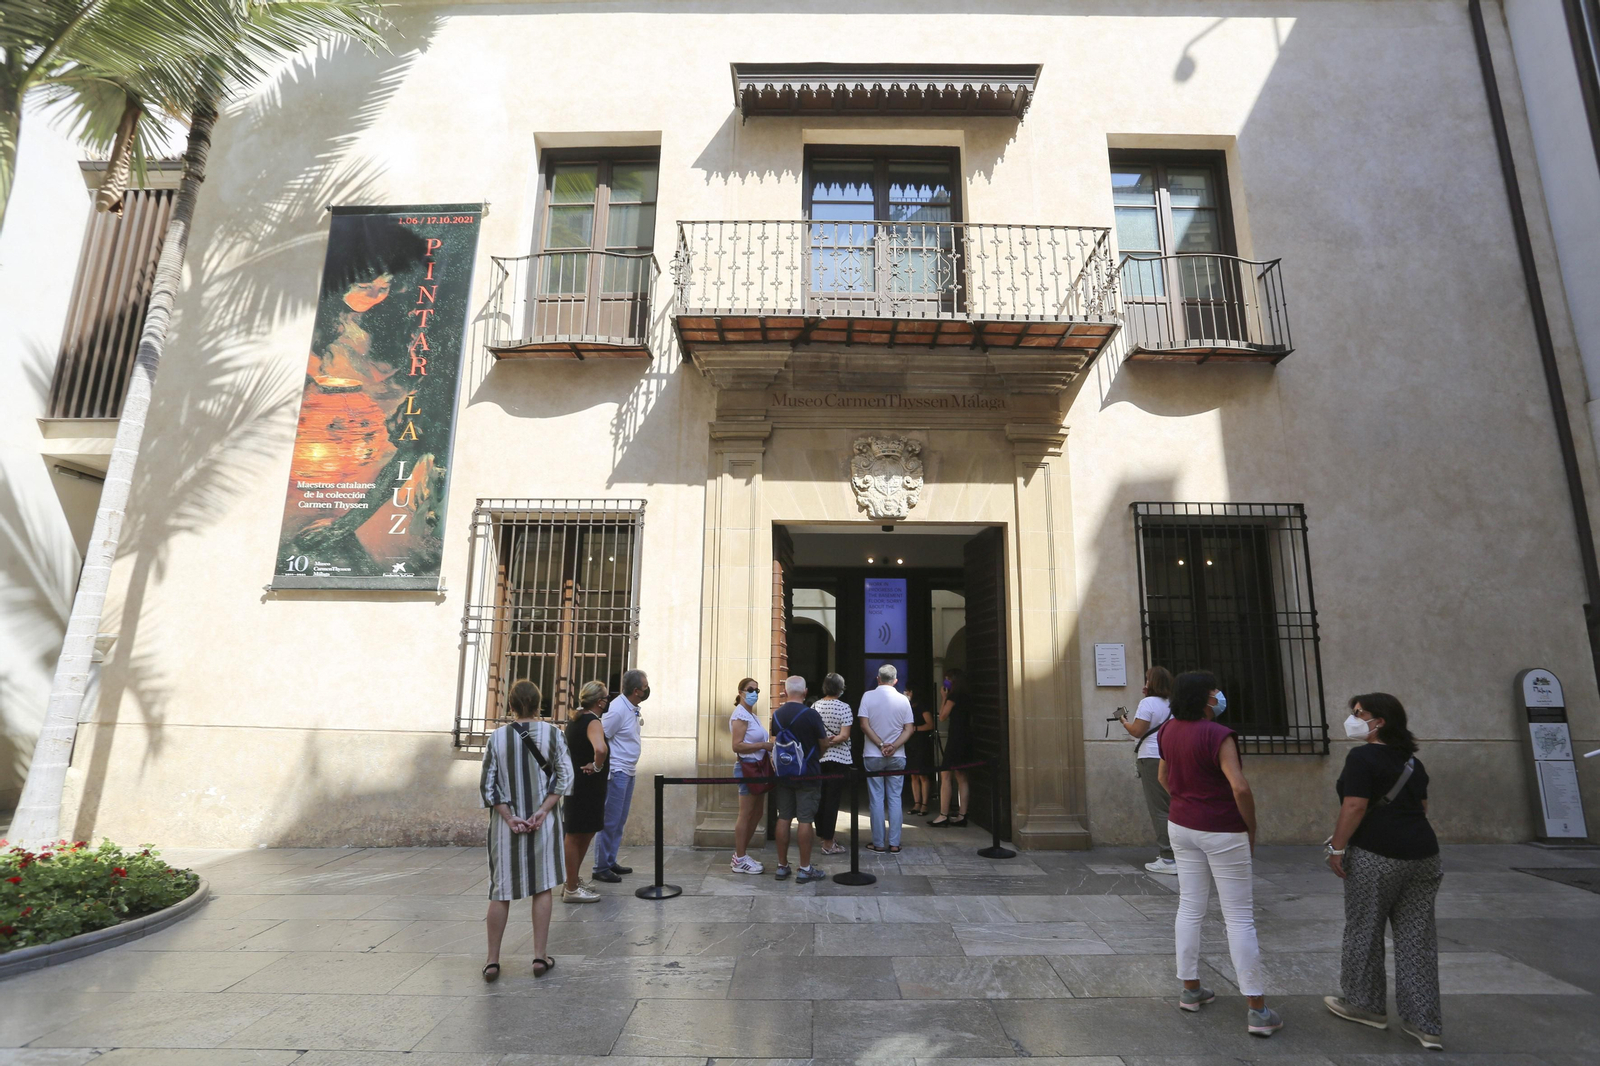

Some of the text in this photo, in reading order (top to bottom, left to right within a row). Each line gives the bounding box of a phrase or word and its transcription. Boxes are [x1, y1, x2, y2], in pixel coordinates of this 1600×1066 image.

[398, 216, 474, 225] 1.06 / 17.10.2021
[408, 238, 442, 376] PINTAR
[772, 393, 823, 407] Museo
[951, 394, 1006, 410] Málaga
[398, 395, 422, 441] LA
[297, 480, 376, 489] Maestros catalanes
[298, 500, 368, 510] Carmen Thyssen
[388, 460, 413, 534] LUZ
[286, 555, 309, 572] 10
